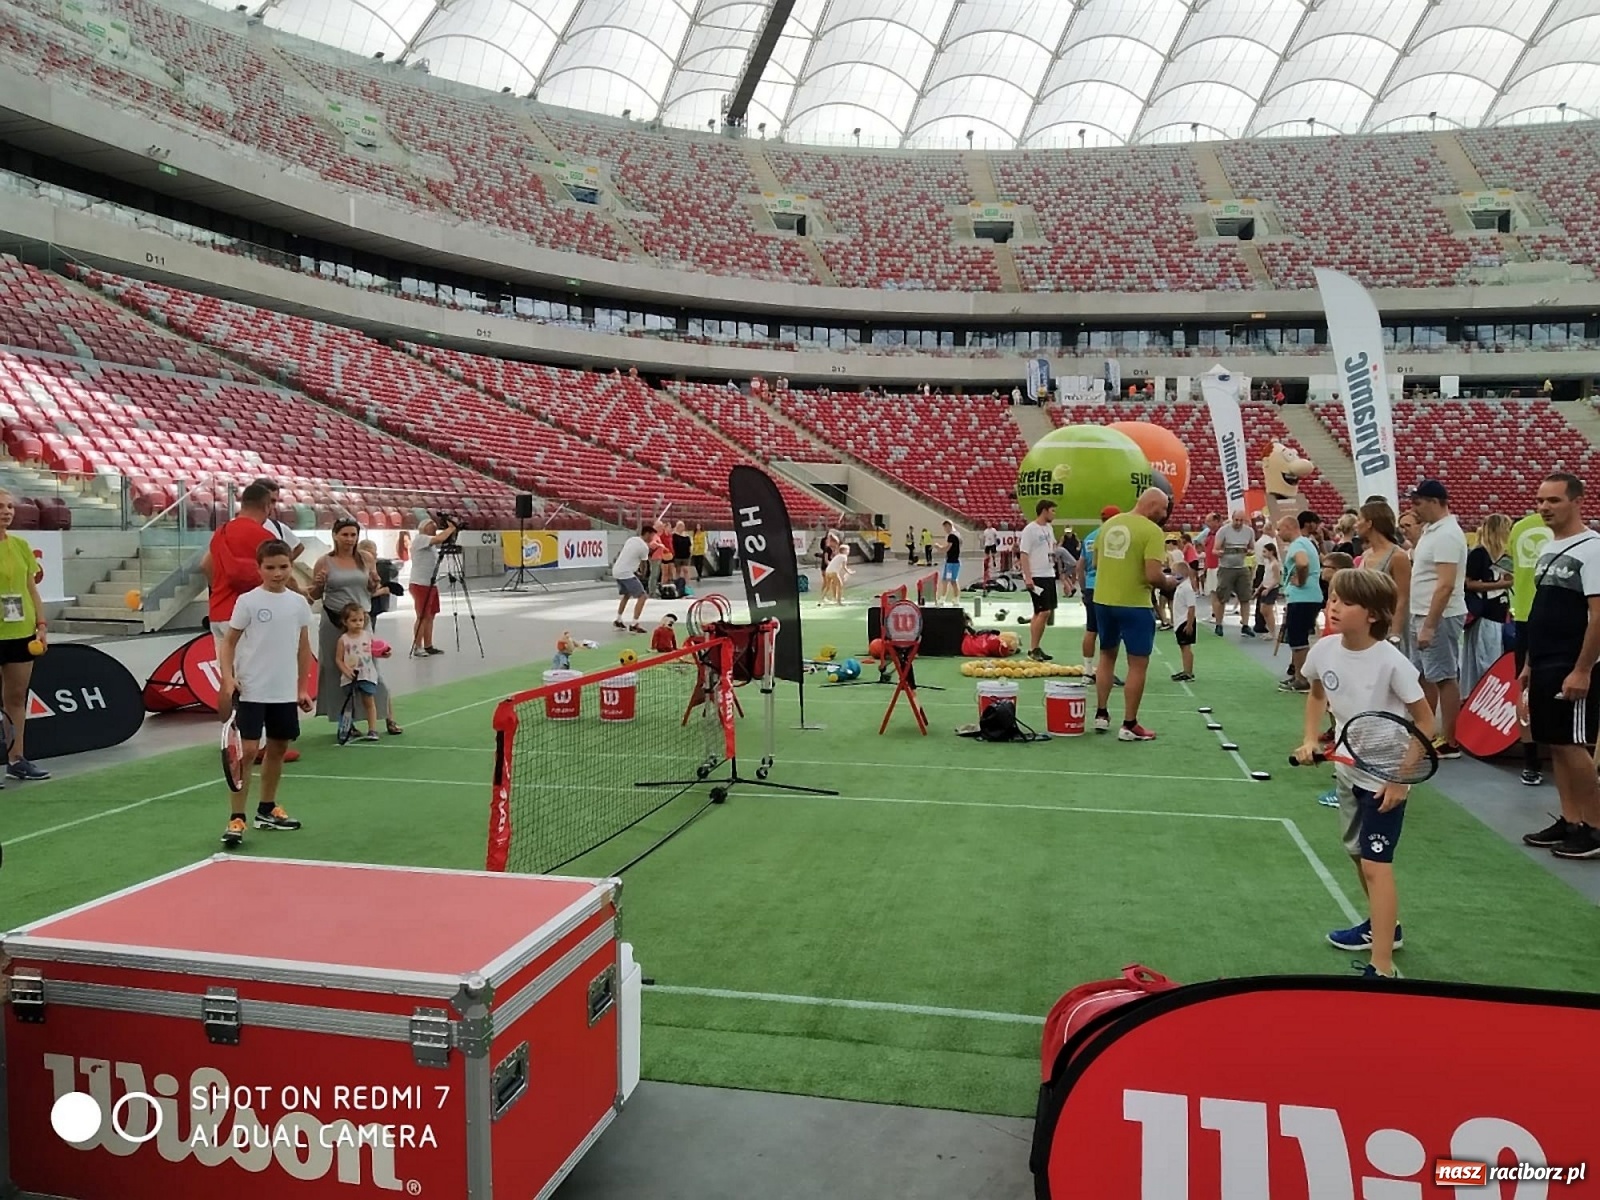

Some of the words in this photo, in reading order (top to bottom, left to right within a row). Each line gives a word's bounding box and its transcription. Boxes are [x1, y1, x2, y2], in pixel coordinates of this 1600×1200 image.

[145, 252, 166, 266] D11
[476, 328, 492, 338] D12
[576, 540, 603, 558] LOTOS
[1468, 674, 1518, 734] Wilson
[43, 1052, 404, 1192] Wilson
